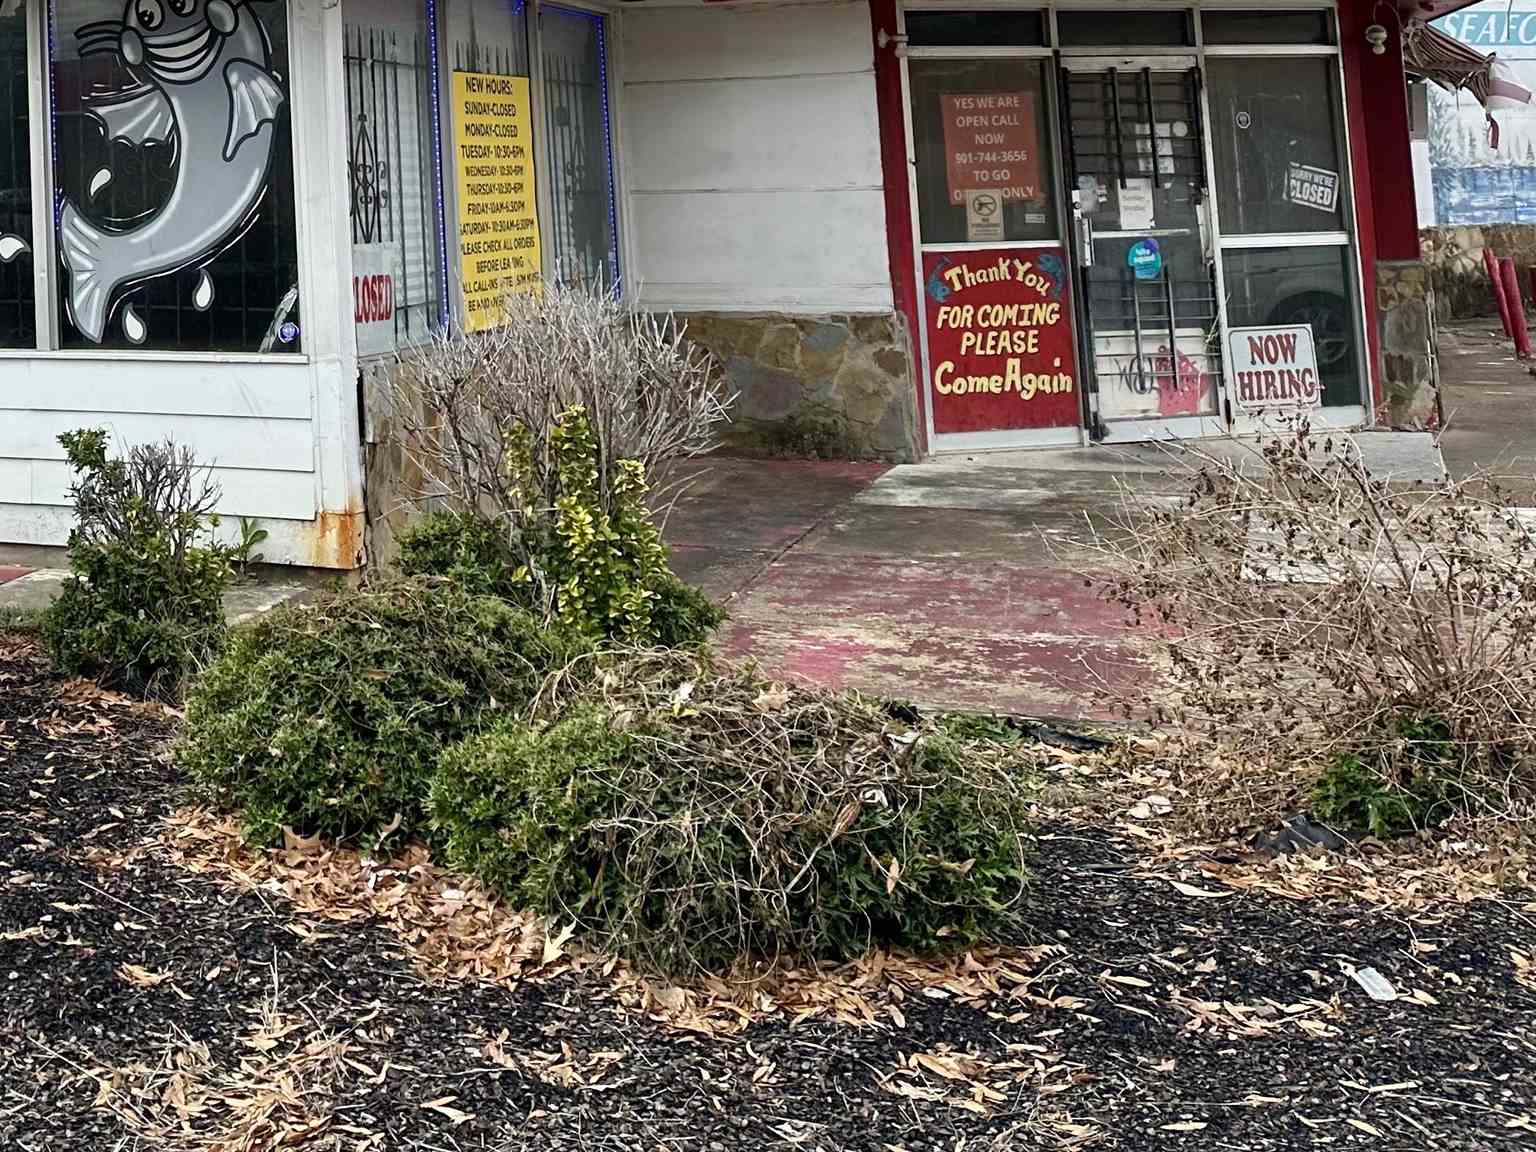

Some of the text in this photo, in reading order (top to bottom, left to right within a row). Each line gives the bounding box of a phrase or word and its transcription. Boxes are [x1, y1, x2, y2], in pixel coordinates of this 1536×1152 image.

[465, 77, 513, 95] NEW HOURS:
[464, 101, 517, 117] SUNDAY-CLOSED
[954, 96, 1020, 109] YES WE ARE
[956, 115, 1020, 127] OPEN CALL
[465, 123, 518, 138] MONDAY-CLOSED
[975, 133, 1005, 145] NOW
[955, 150, 1028, 164] 901-744-3656
[973, 169, 1011, 182] TO GO
[1002, 185, 1034, 199] ONLY
[1290, 178, 1332, 206] CLOSED
[483, 239, 501, 253] CHECK
[503, 239, 513, 251] ALL
[476, 256, 524, 274] BEFORE LEAING
[1013, 258, 1051, 297] You
[352, 274, 393, 324] LOSED
[937, 302, 1061, 329] FOR COMING
[960, 329, 1040, 356] PLEASE
[1247, 333, 1297, 366] NOW
[935, 360, 1004, 395] Come
[1004, 357, 1073, 401] Again
[1237, 367, 1315, 401] HIRING
